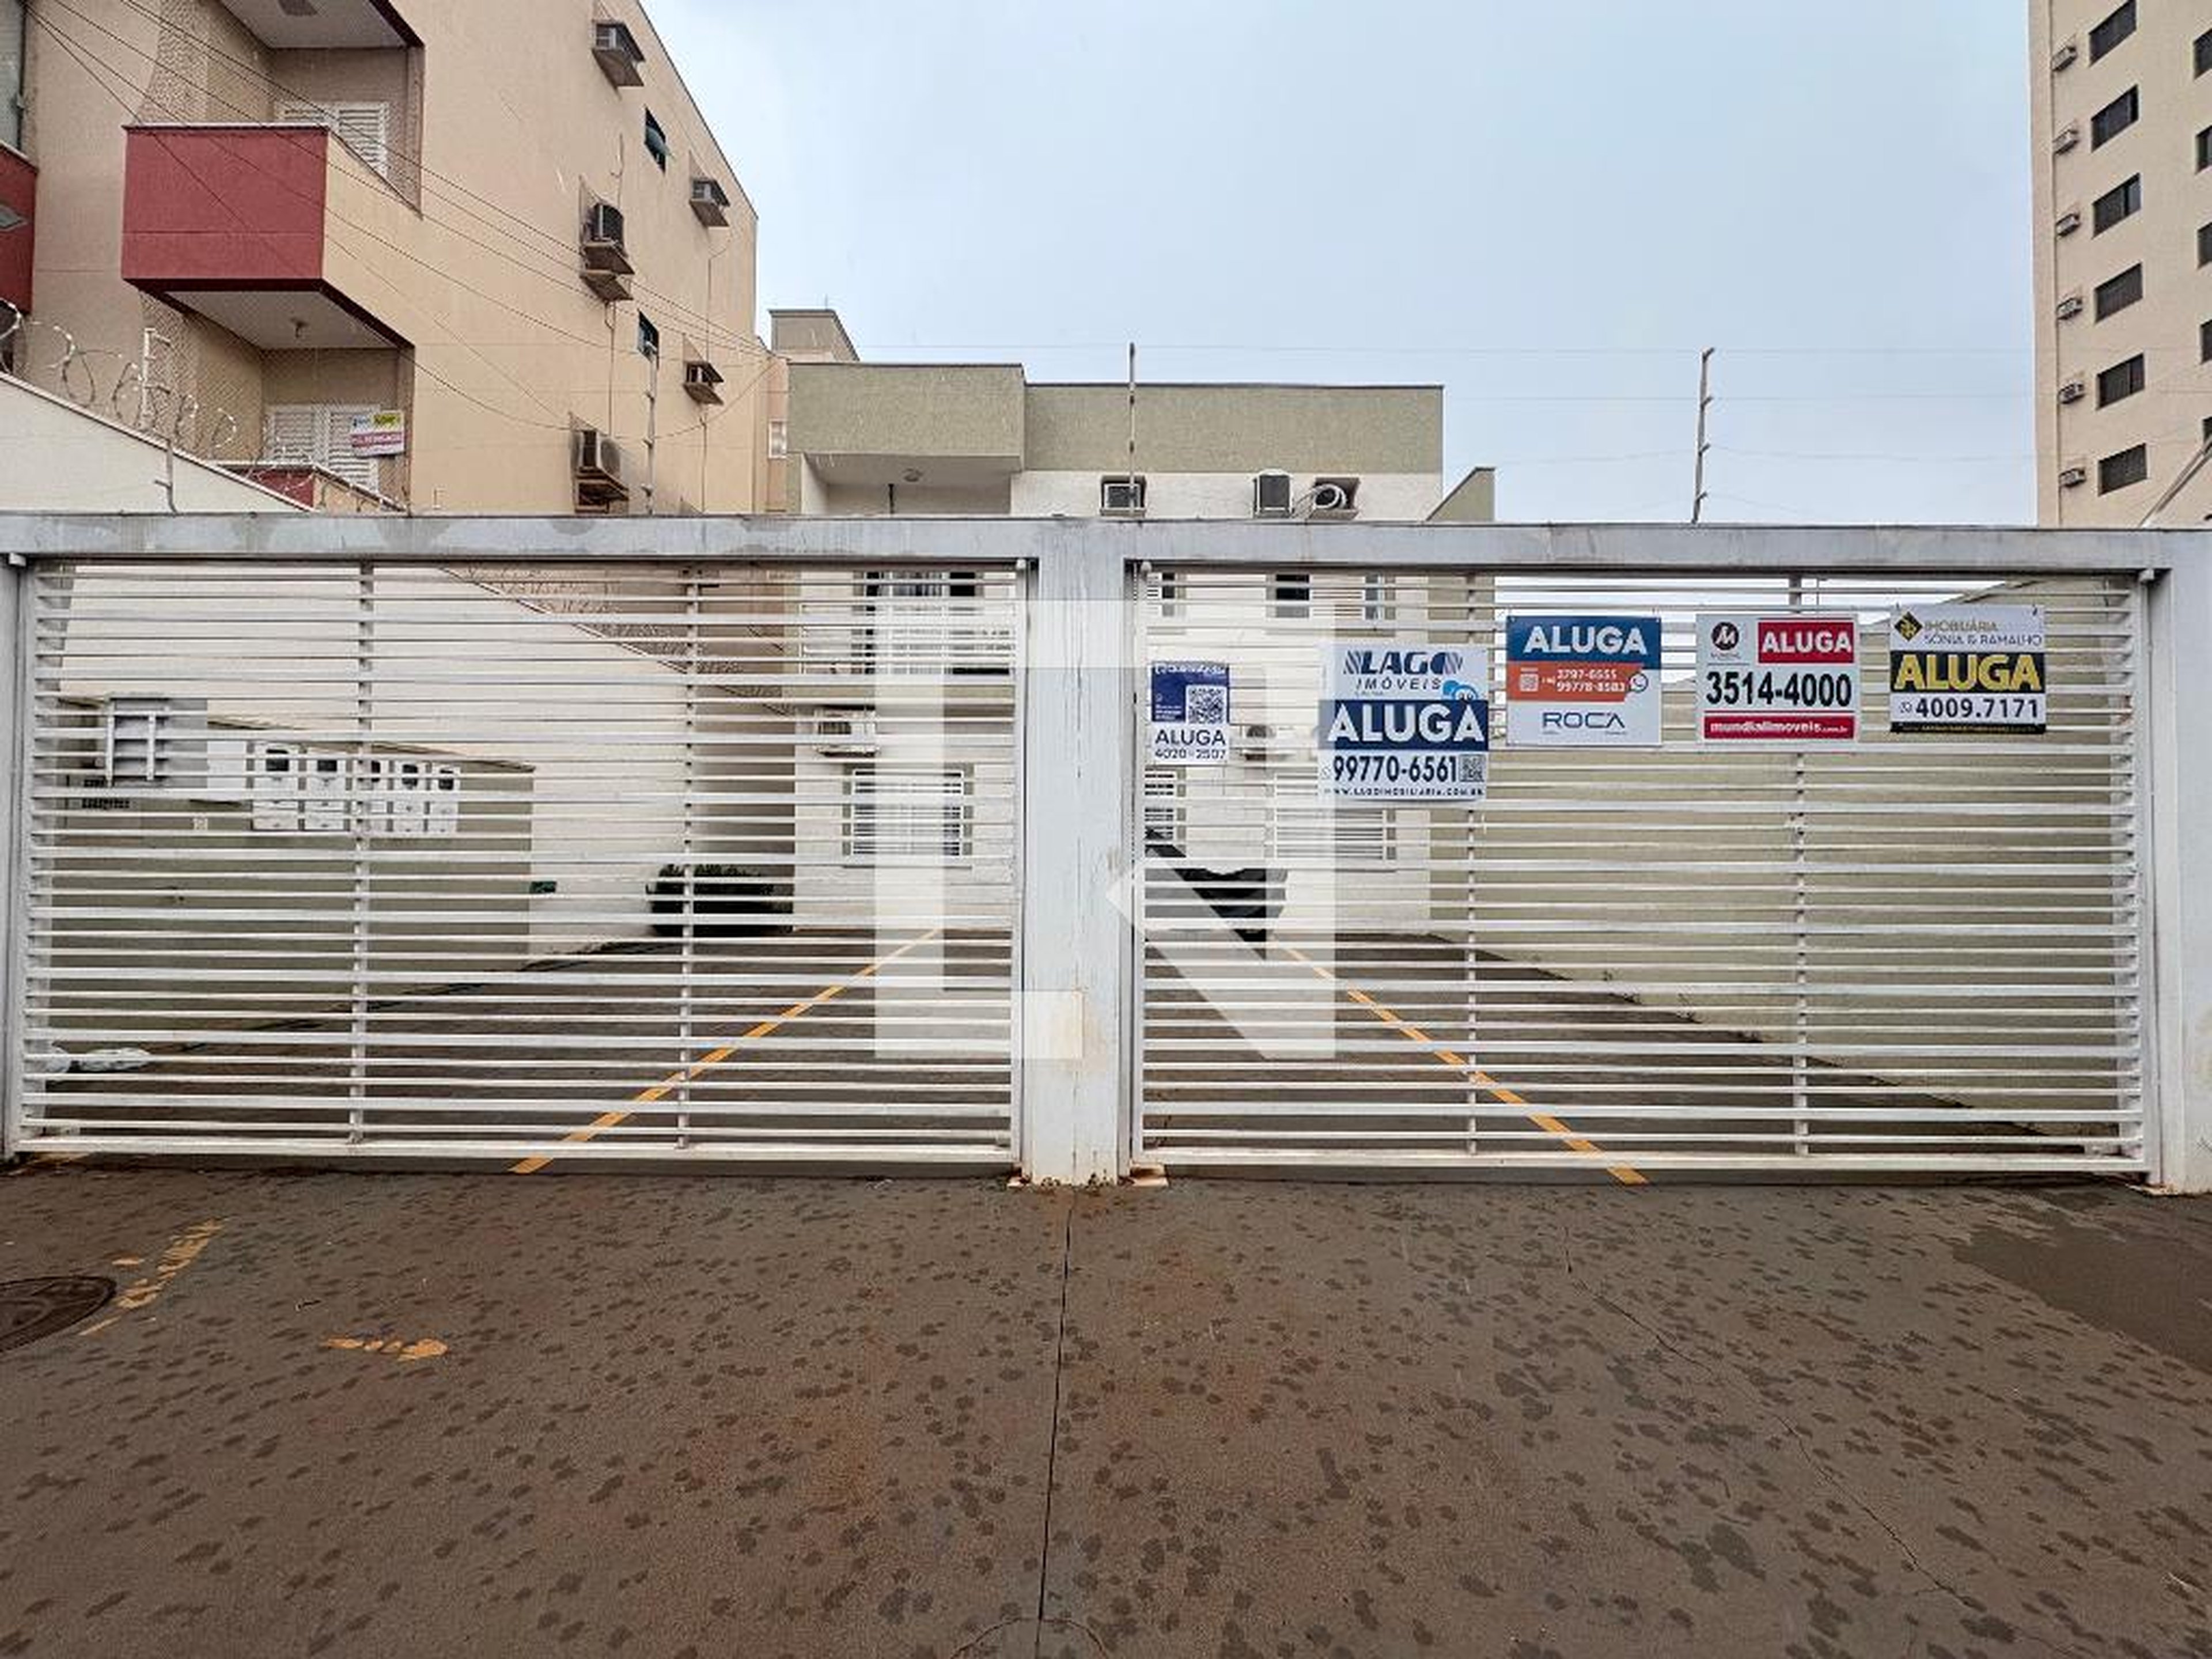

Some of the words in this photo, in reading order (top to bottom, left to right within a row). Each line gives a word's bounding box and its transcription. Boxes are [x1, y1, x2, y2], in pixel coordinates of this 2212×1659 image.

[1523, 626, 1647, 654] ALUGA
[1762, 631, 1851, 652] ALUGA
[1358, 652, 1463, 675] LAGO
[1894, 654, 2041, 690] ALUGA
[1355, 677, 1441, 690] IMÓVEIS
[1706, 672, 1851, 706] 3514-4000
[1916, 698, 2038, 718] 4009.7171
[1328, 703, 1485, 742] ALUGA
[1542, 712, 1626, 728] ROCA
[1155, 729, 1226, 745] ALUGA
[1334, 755, 1457, 782] 99770-6561
